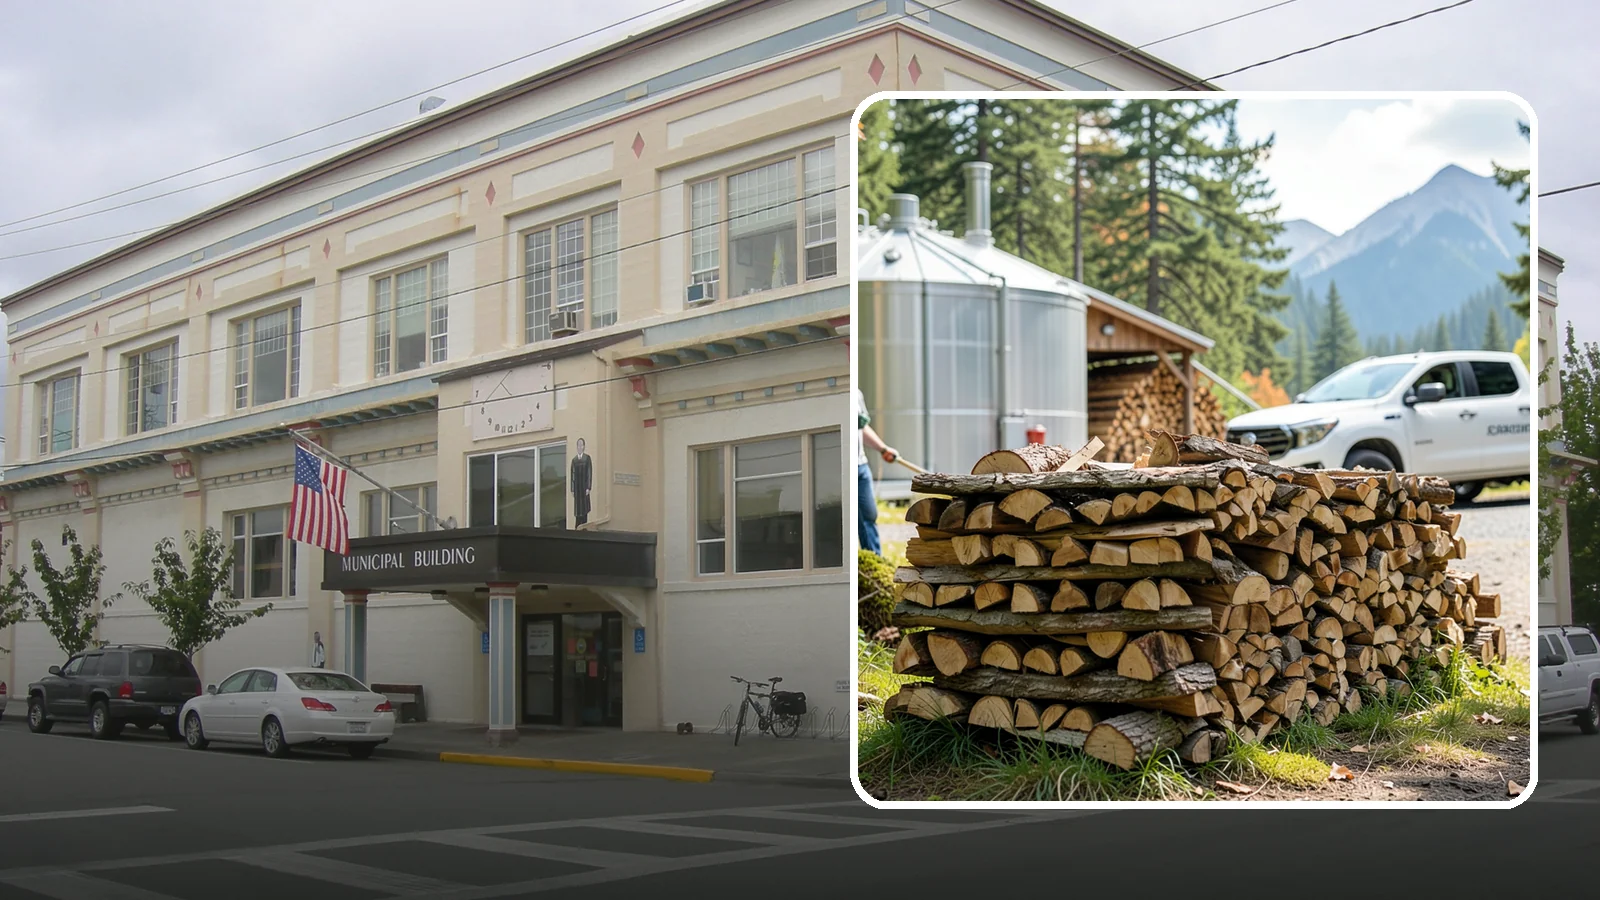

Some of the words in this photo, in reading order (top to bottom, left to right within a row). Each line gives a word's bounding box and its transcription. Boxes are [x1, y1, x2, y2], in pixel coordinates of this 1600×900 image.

[475, 390, 479, 398] 7
[487, 417, 492, 426] 9
[529, 414, 533, 422] 3
[521, 420, 525, 428] 2
[342, 552, 405, 572] MUNICIPAL
[414, 546, 476, 568] BUILDING
